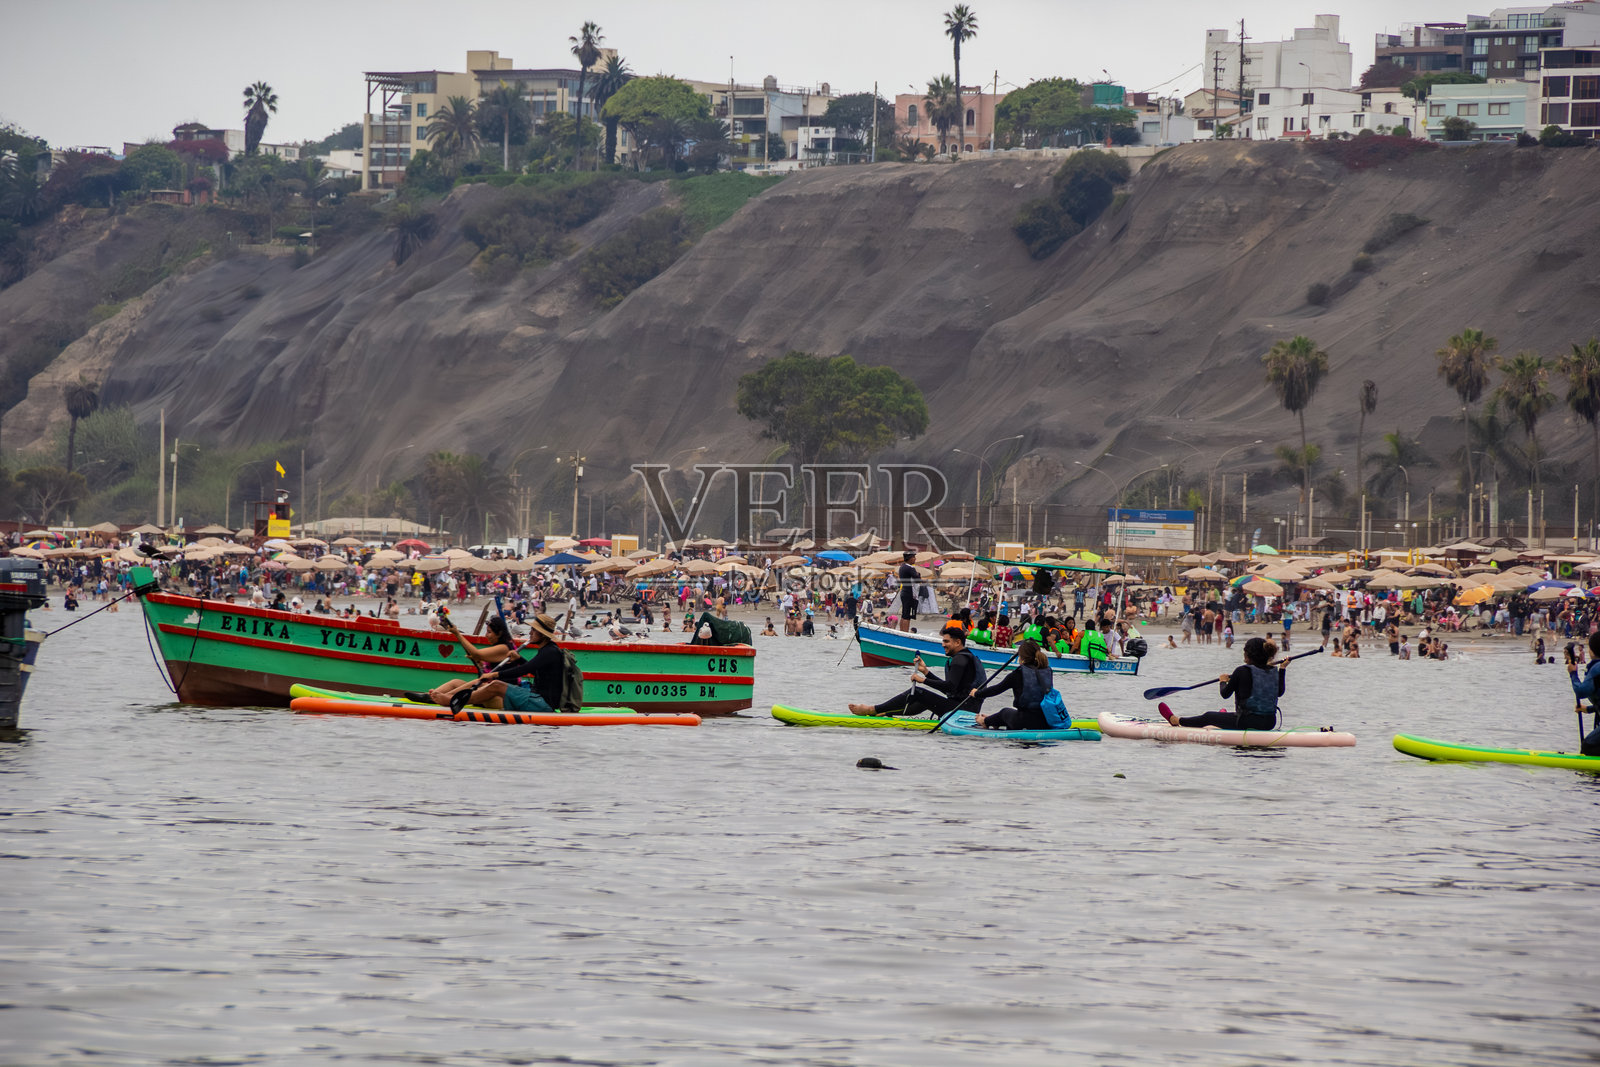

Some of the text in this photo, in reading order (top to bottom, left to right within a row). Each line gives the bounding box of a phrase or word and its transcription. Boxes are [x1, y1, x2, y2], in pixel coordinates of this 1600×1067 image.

[221, 616, 421, 657] ERIKA YOLANDA
[635, 685, 687, 697] 000335
